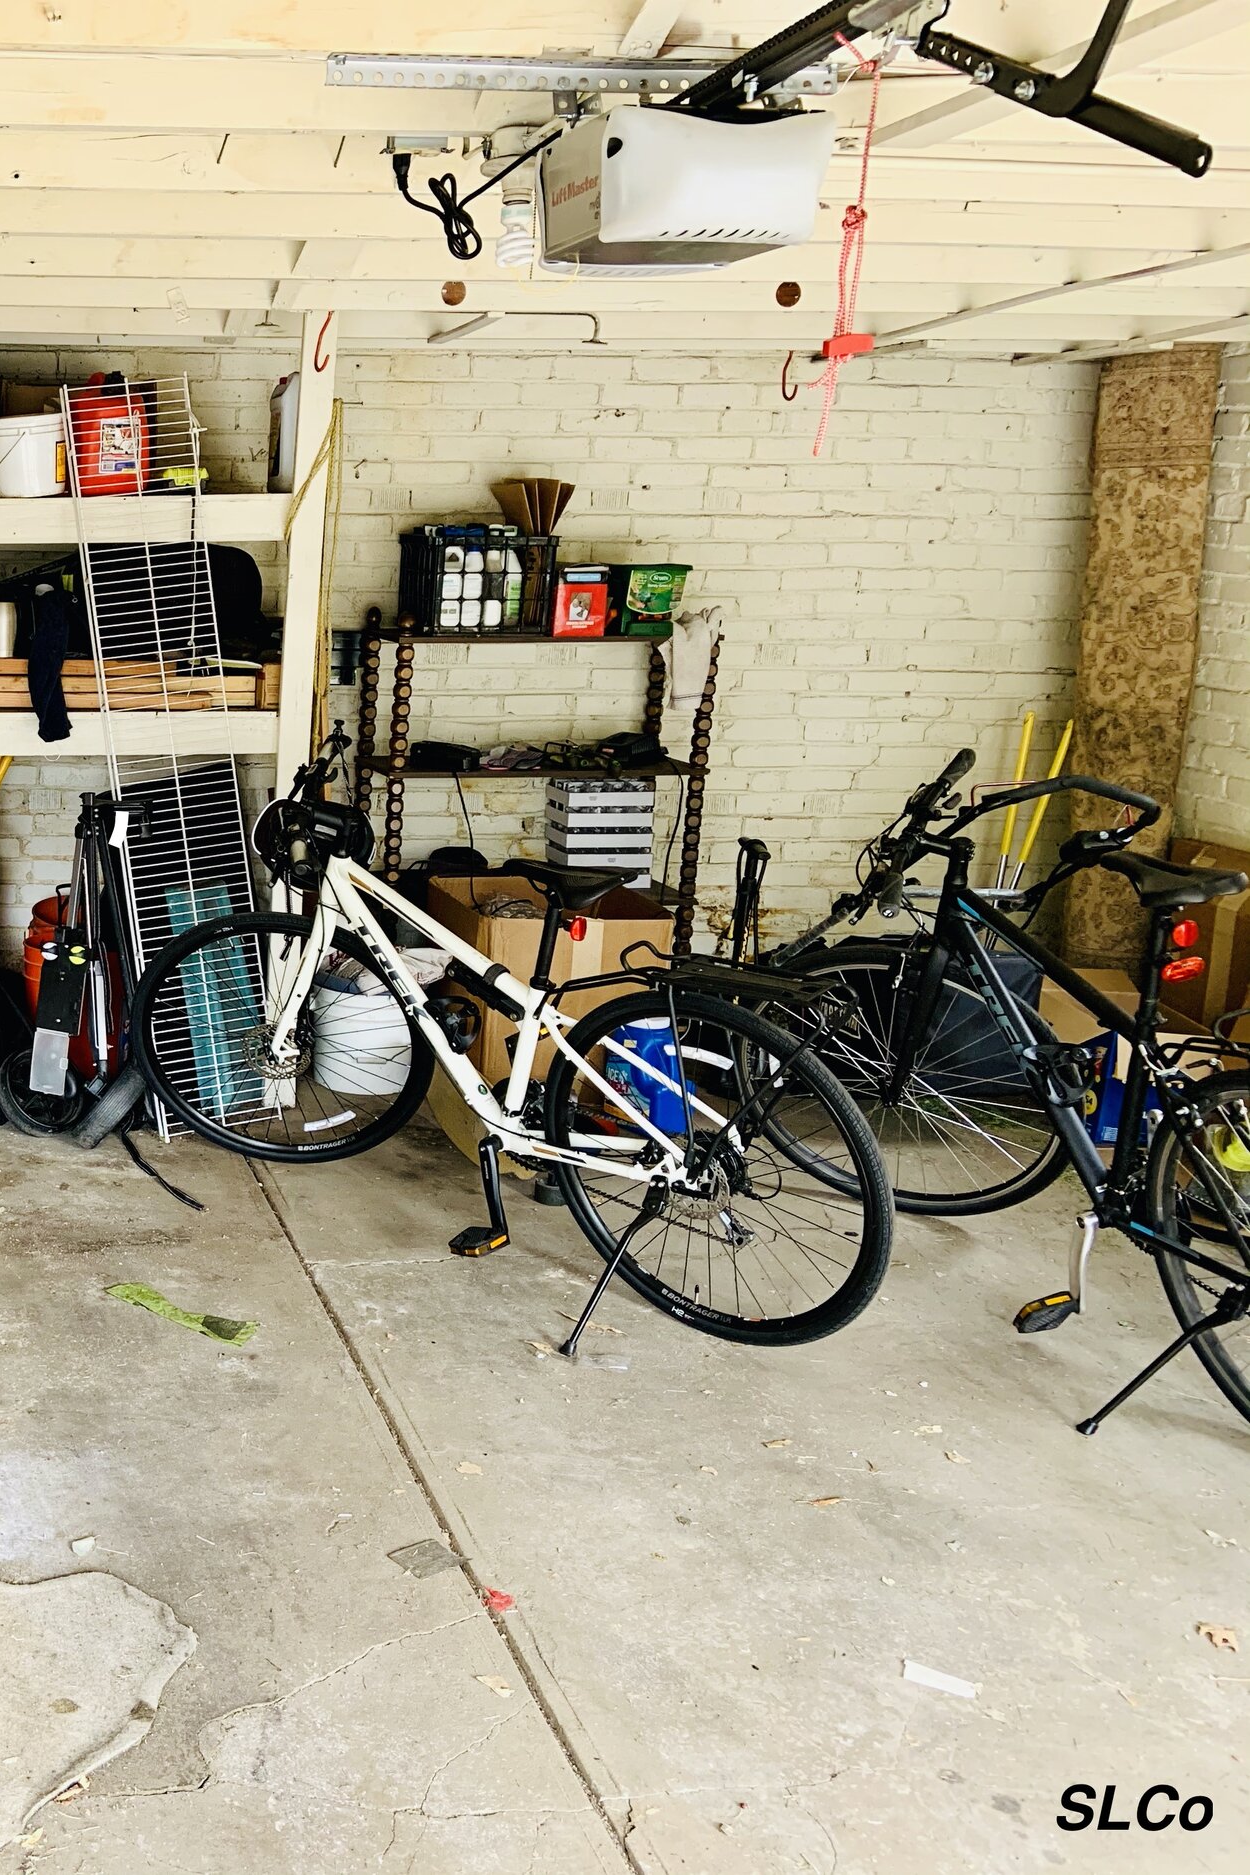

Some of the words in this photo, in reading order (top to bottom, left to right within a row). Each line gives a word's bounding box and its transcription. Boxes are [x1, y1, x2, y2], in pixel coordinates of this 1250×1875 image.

[551, 175, 599, 208] LiftMaster
[353, 916, 430, 1021] TREK
[968, 954, 1036, 1072] TREK
[303, 1138, 347, 1151] BONTRAGER
[666, 1293, 720, 1320] BONTRAGER
